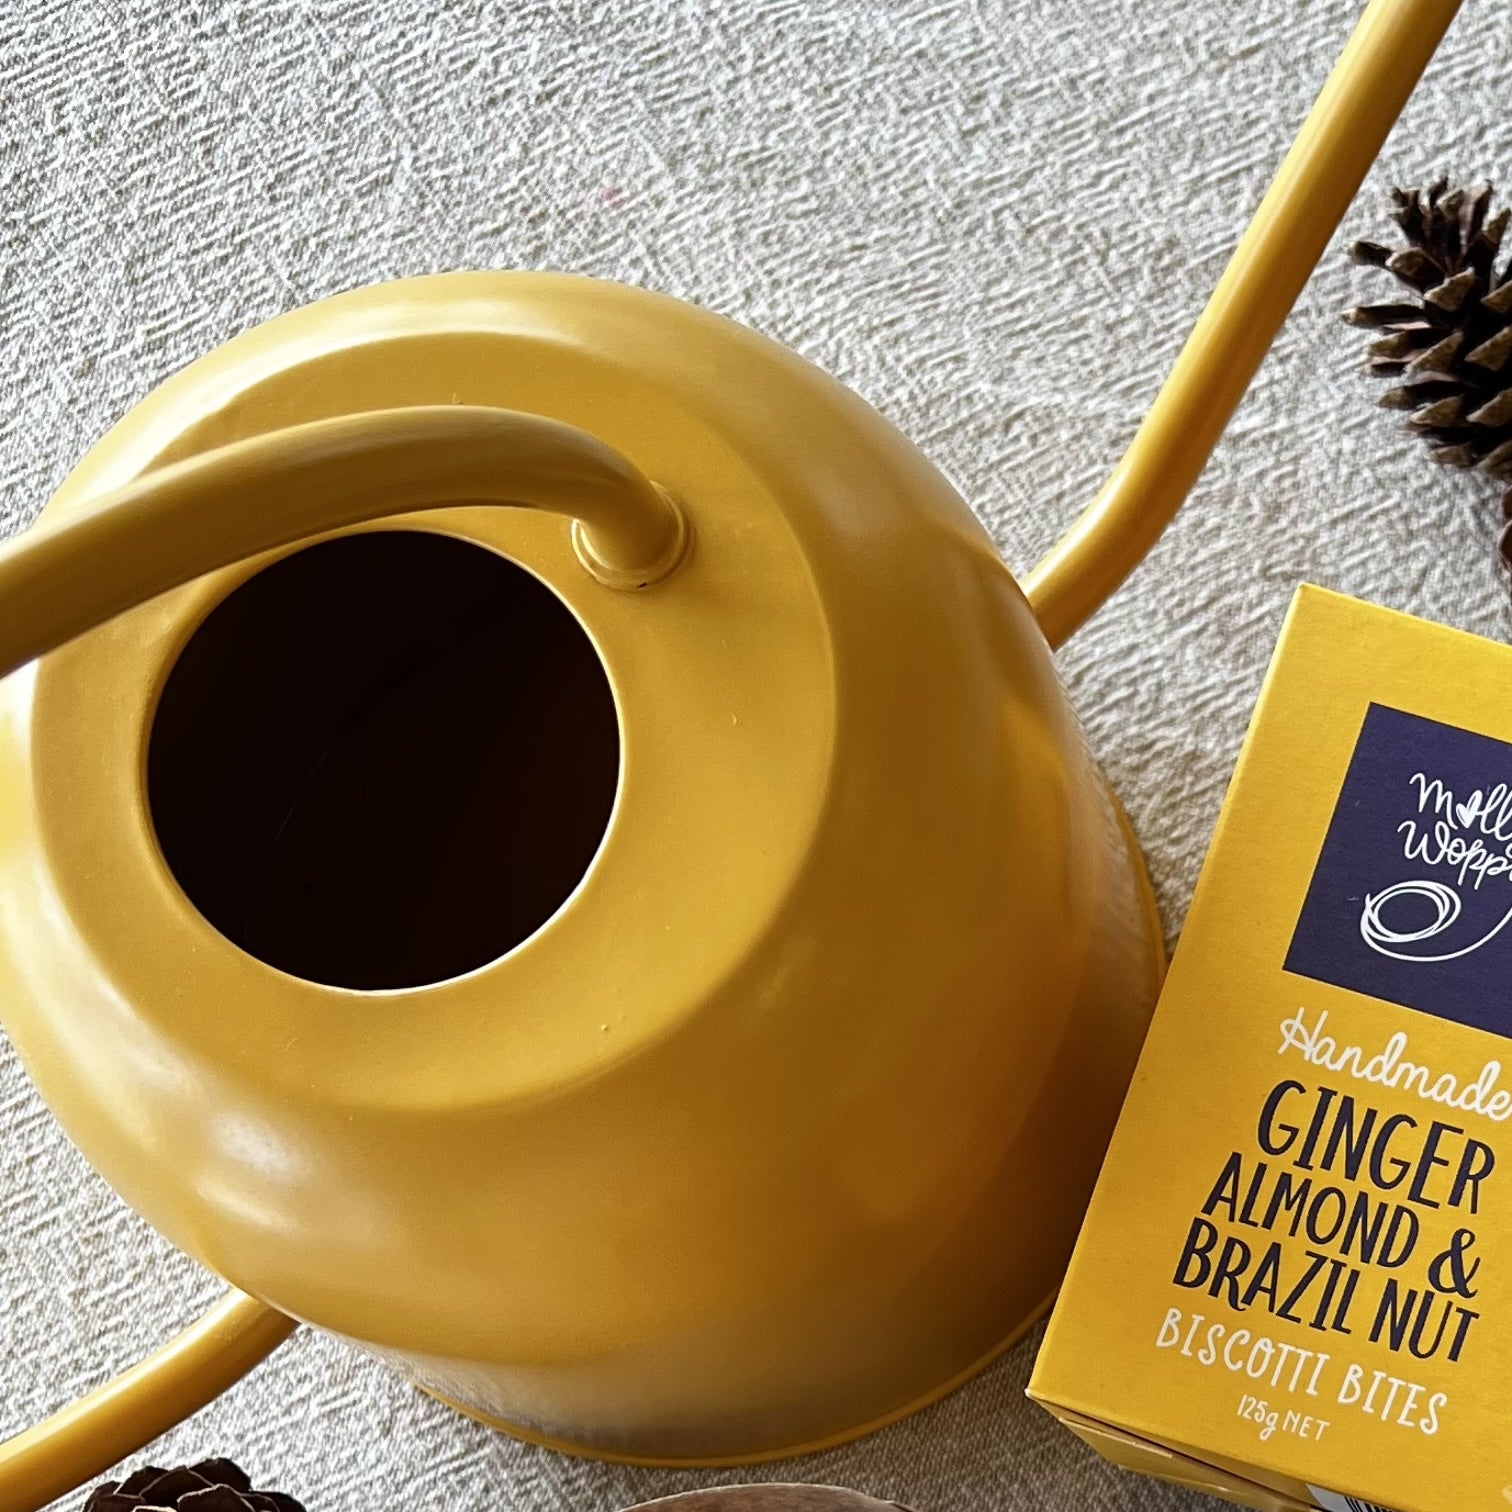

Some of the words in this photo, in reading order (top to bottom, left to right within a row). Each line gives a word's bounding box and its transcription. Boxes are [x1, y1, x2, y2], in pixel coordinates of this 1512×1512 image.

[1258, 1080, 1494, 1214] GINGER
[1172, 1217, 1376, 1336] BRAZIL
[1370, 1283, 1480, 1361] NUT
[1201, 1151, 1422, 1272] ALMOND
[1428, 1227, 1480, 1299] &
[1156, 1307, 1331, 1396] BISCOTTI
[1338, 1365, 1447, 1435] BITES
[1237, 1395, 1279, 1442] 125g
[1282, 1409, 1330, 1441] NET
